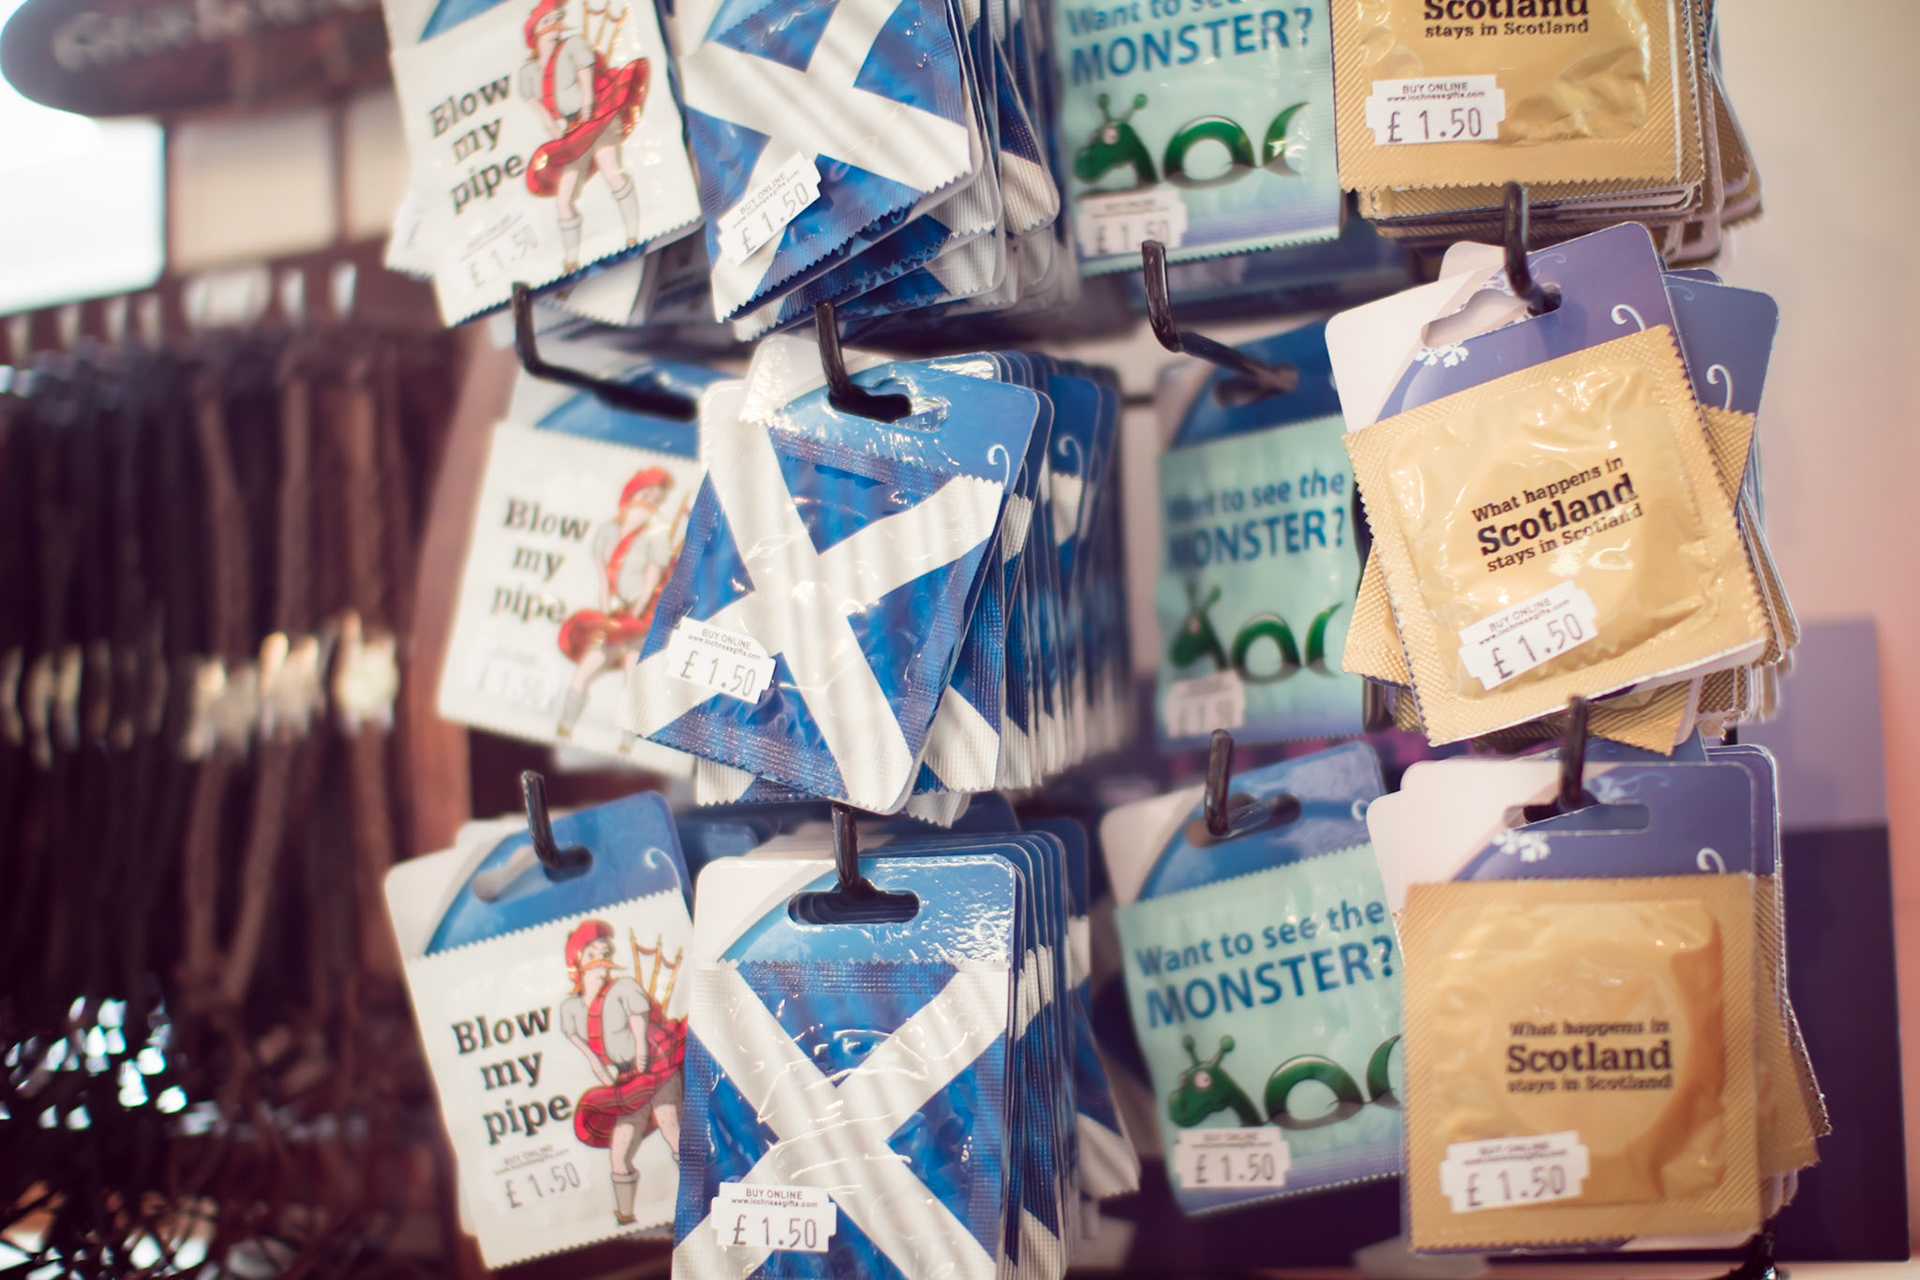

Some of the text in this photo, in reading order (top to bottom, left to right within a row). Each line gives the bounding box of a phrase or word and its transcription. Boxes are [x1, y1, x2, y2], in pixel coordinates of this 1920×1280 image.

[1066, 1, 1140, 36] Want
[1150, 0, 1181, 19] to
[1425, 19, 1589, 39] stays in Scotland
[1070, 7, 1313, 84] MONSTER?
[429, 74, 511, 138] Blow
[1402, 82, 1468, 94] BUY ONLINE
[452, 117, 503, 163] my
[450, 154, 526, 215] pipe
[1252, 481, 1292, 509] see
[1299, 468, 1344, 499] the
[1471, 457, 1624, 523] What happens in
[504, 499, 589, 541] Blow
[1477, 473, 1638, 556] Scotland
[514, 548, 564, 581] my
[1487, 547, 1536, 573] stays
[1539, 539, 1559, 554] in
[492, 584, 568, 623] pipe
[1512, 597, 1552, 619] ONLINE
[702, 628, 752, 651] BUY ONLINE
[1136, 900, 1386, 977] Want to see the
[1145, 934, 1393, 1029] MONSTER?
[451, 1005, 551, 1055] Blow
[1510, 1017, 1671, 1037] What happens in
[480, 1051, 543, 1090] my
[1507, 1039, 1672, 1073] Scotland
[1507, 1073, 1673, 1093] stays in Scotland
[483, 1094, 573, 1145] pipe
[746, 1188, 803, 1200] BUY ONLINE
